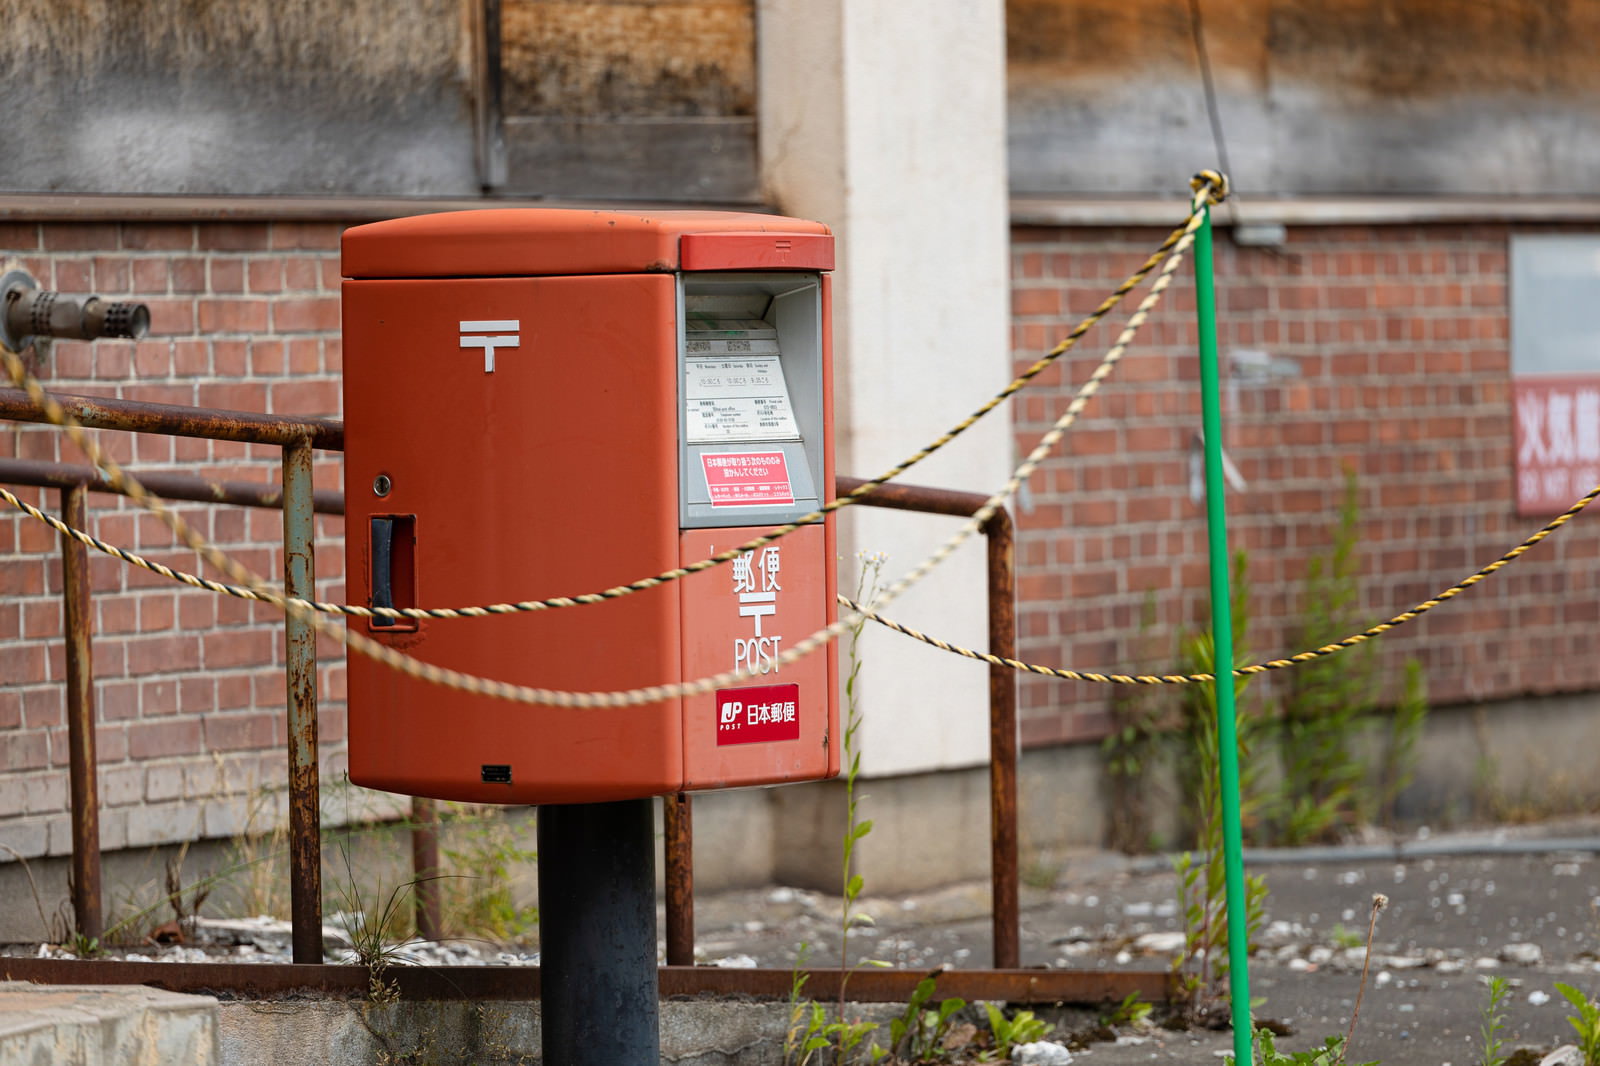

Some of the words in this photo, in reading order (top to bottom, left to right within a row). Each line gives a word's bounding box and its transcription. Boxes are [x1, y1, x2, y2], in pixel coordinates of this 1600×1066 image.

[732, 546, 782, 593] 郵便
[733, 636, 782, 676] POST
[719, 723, 742, 731] POST
[747, 701, 796, 726] 日本郵便
